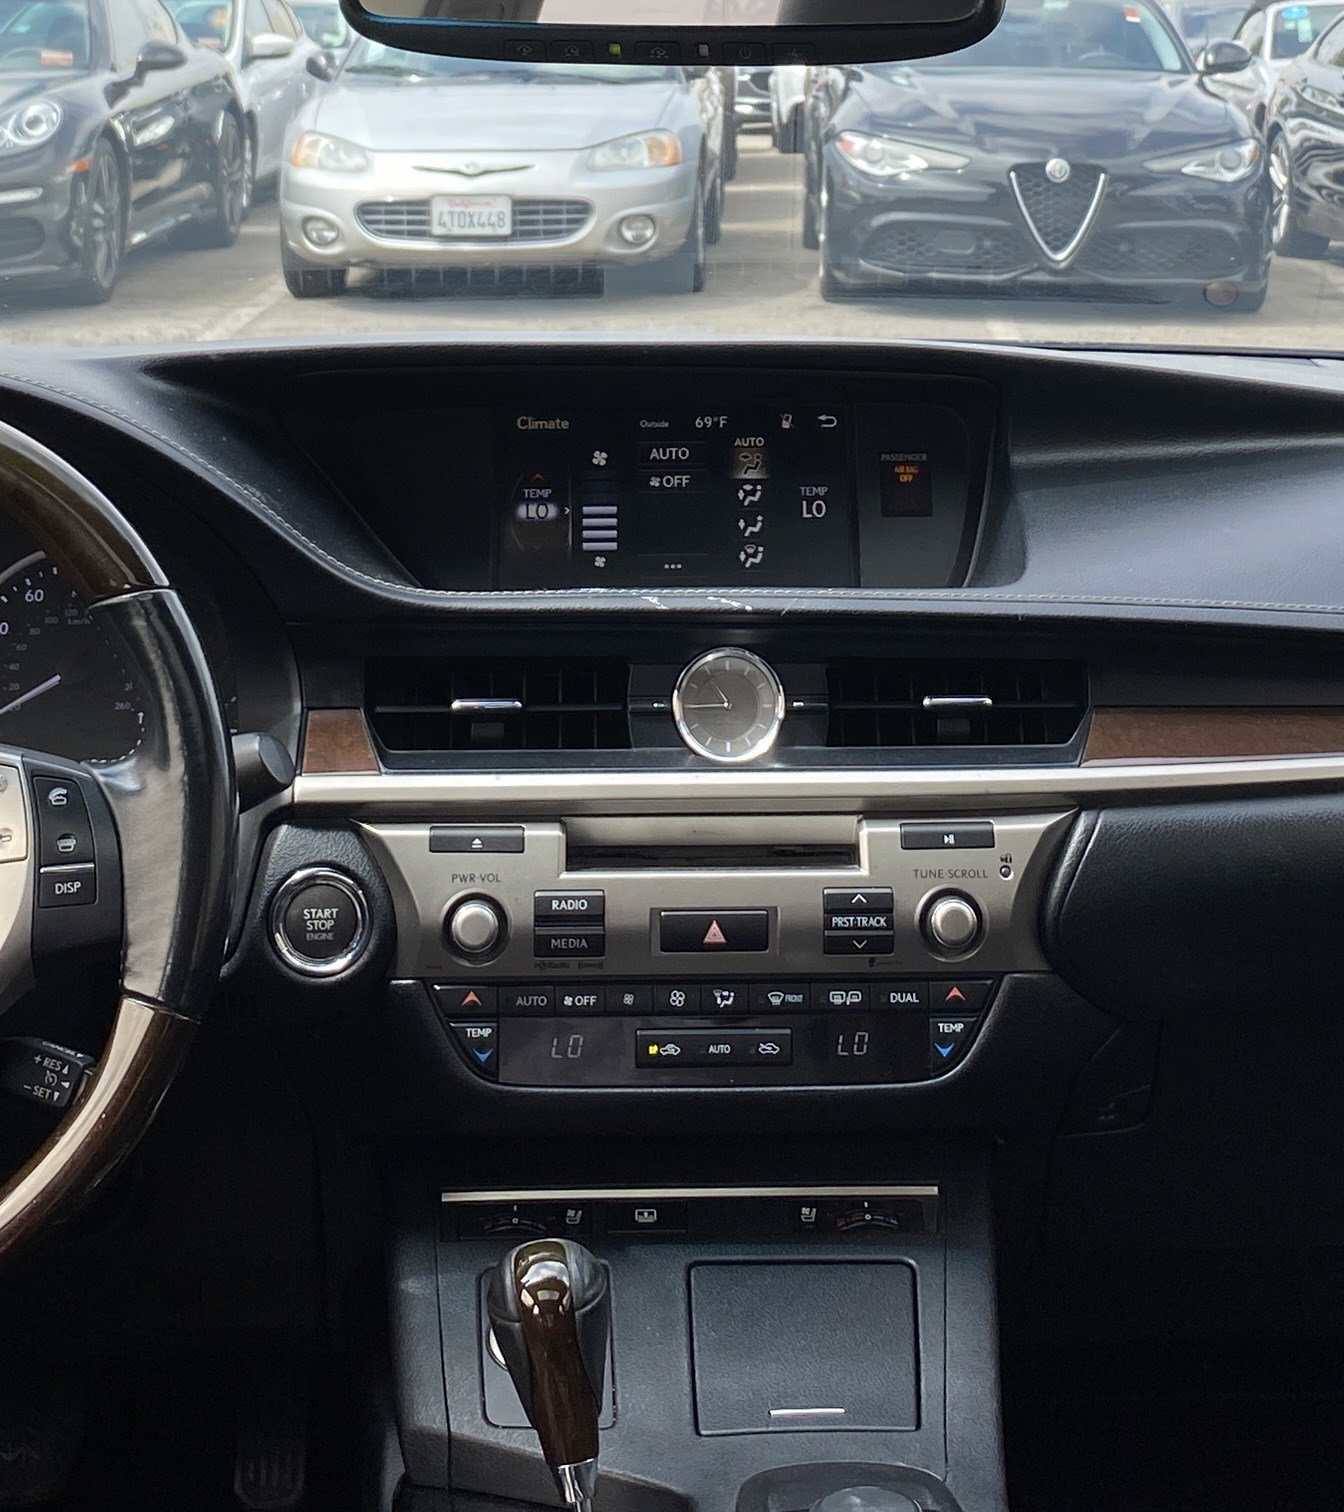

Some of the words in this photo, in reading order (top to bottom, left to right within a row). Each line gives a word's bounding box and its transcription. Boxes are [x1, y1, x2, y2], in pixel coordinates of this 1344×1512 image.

[516, 415, 570, 430] Climate
[639, 419, 670, 428] Outside
[695, 415, 729, 429] 69°F
[734, 436, 765, 447] AUTO
[649, 447, 690, 460] AUTO
[880, 452, 928, 462] PASSENGER
[662, 474, 692, 488] OFF
[899, 474, 914, 483] OFF
[522, 488, 553, 499] TEMP
[798, 486, 829, 497] TEMP
[525, 503, 549, 519] LO
[801, 500, 827, 518] LO
[24, 589, 45, 603] 60
[54, 881, 82, 895] DISP
[551, 898, 589, 911] RADIO
[302, 907, 339, 920] START
[306, 919, 336, 931] STOP
[305, 931, 336, 942] ENGINE
[550, 937, 589, 951] MEDIA
[515, 994, 548, 1007] AUTO
[574, 993, 598, 1007] OFF
[784, 993, 804, 1004] FRONT
[889, 990, 920, 1004] DUAL
[465, 1026, 493, 1039] TEMP
[937, 1022, 965, 1035] TEMP
[551, 1033, 584, 1059] LO
[708, 1043, 732, 1055] AUTO
[837, 1030, 869, 1056] LO
